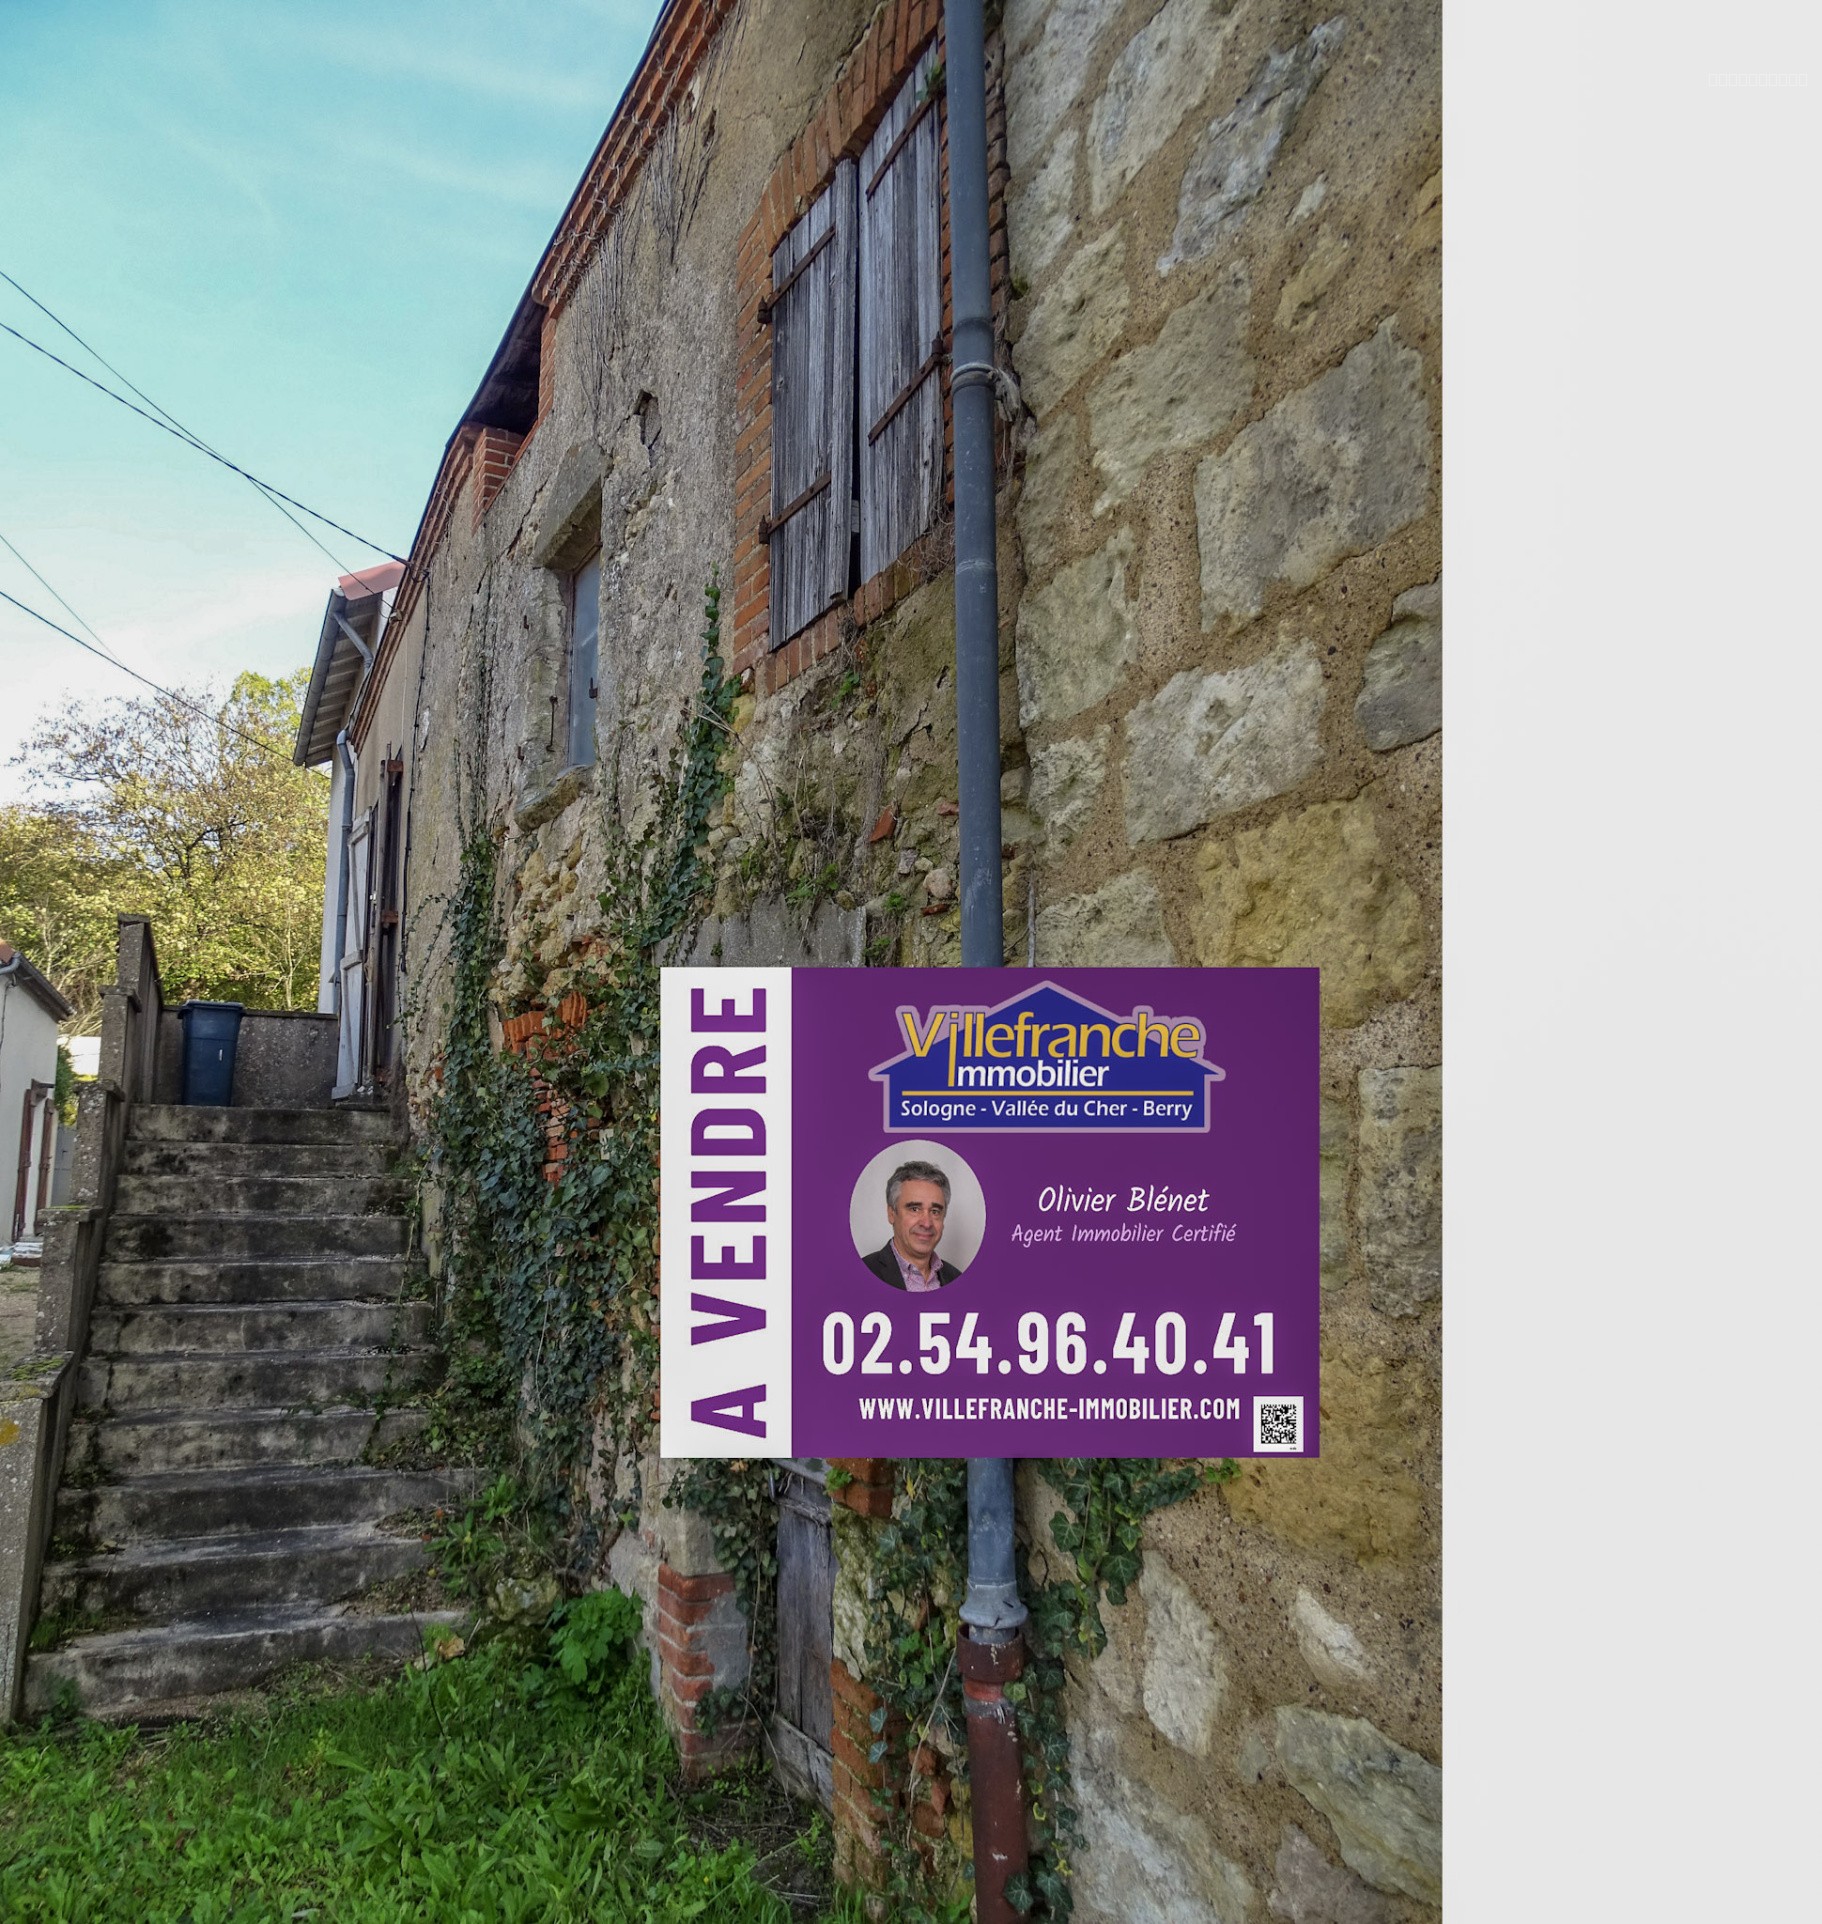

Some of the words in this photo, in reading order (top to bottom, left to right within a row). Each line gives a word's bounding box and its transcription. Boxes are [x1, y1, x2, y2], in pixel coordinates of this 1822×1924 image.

[901, 1011, 1202, 1058] Villefranche
[901, 1101, 976, 1121] Sologne
[992, 1100, 1049, 1116] Vallée
[1055, 1101, 1077, 1116] du
[1084, 1101, 1127, 1116] Cher
[1144, 1101, 1192, 1121] Berry
[691, 988, 766, 1345] VENDRE
[1039, 1185, 1116, 1211] Olivier
[1127, 1185, 1209, 1211] Blénet
[1012, 1224, 1062, 1247] Agent
[1072, 1223, 1164, 1241] Immobilier
[1172, 1223, 1236, 1241] Certifié
[823, 1312, 1273, 1375] 02.54.96.40.41
[691, 1384, 766, 1438] A
[859, 1398, 1239, 1419] WWW.VILLEFRANCHE-IMMOBILIER.COM
